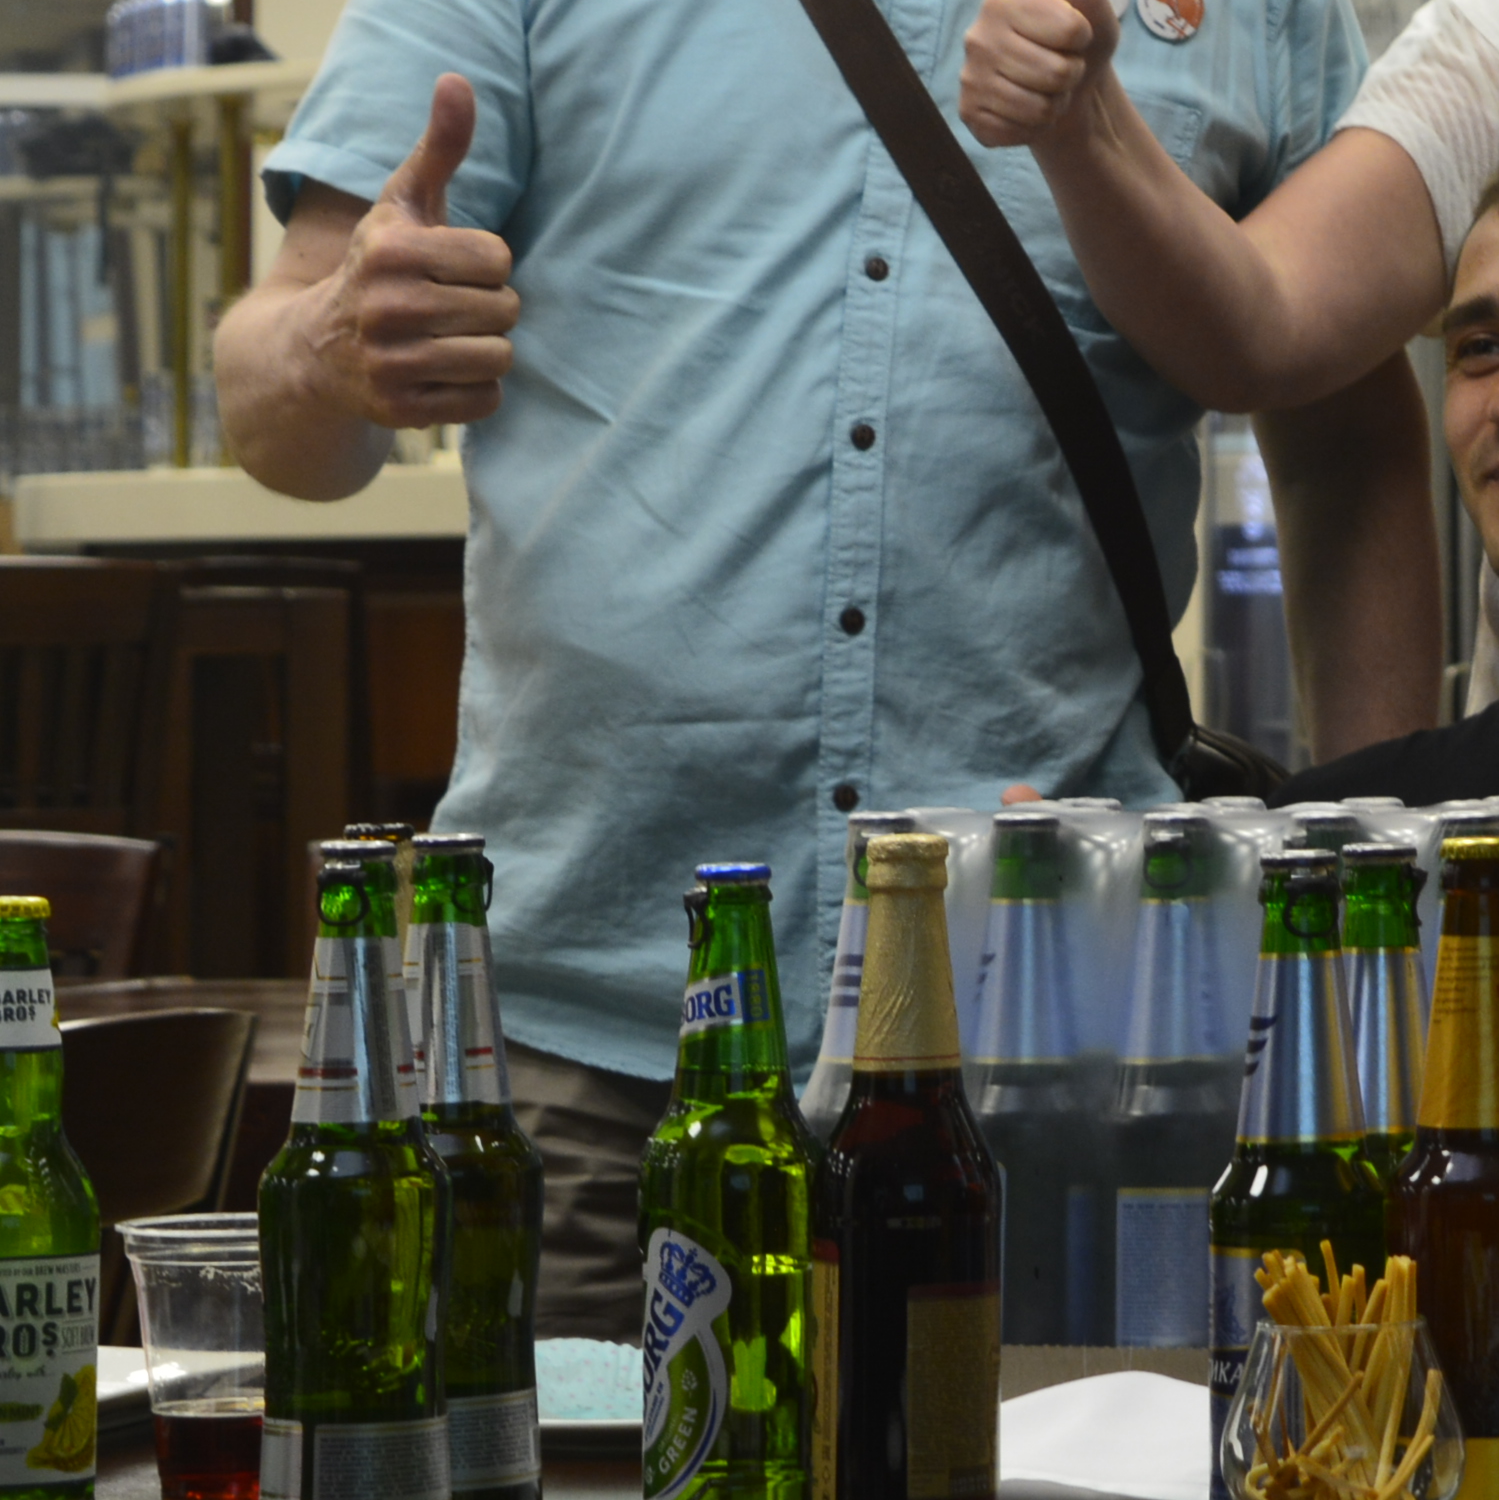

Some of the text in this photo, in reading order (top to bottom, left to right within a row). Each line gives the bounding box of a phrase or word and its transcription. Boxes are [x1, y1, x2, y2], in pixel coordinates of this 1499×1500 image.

[0, 987, 51, 1006] ARLEY
[682, 984, 737, 1025] ORG
[658, 1406, 699, 1477] GREEN
